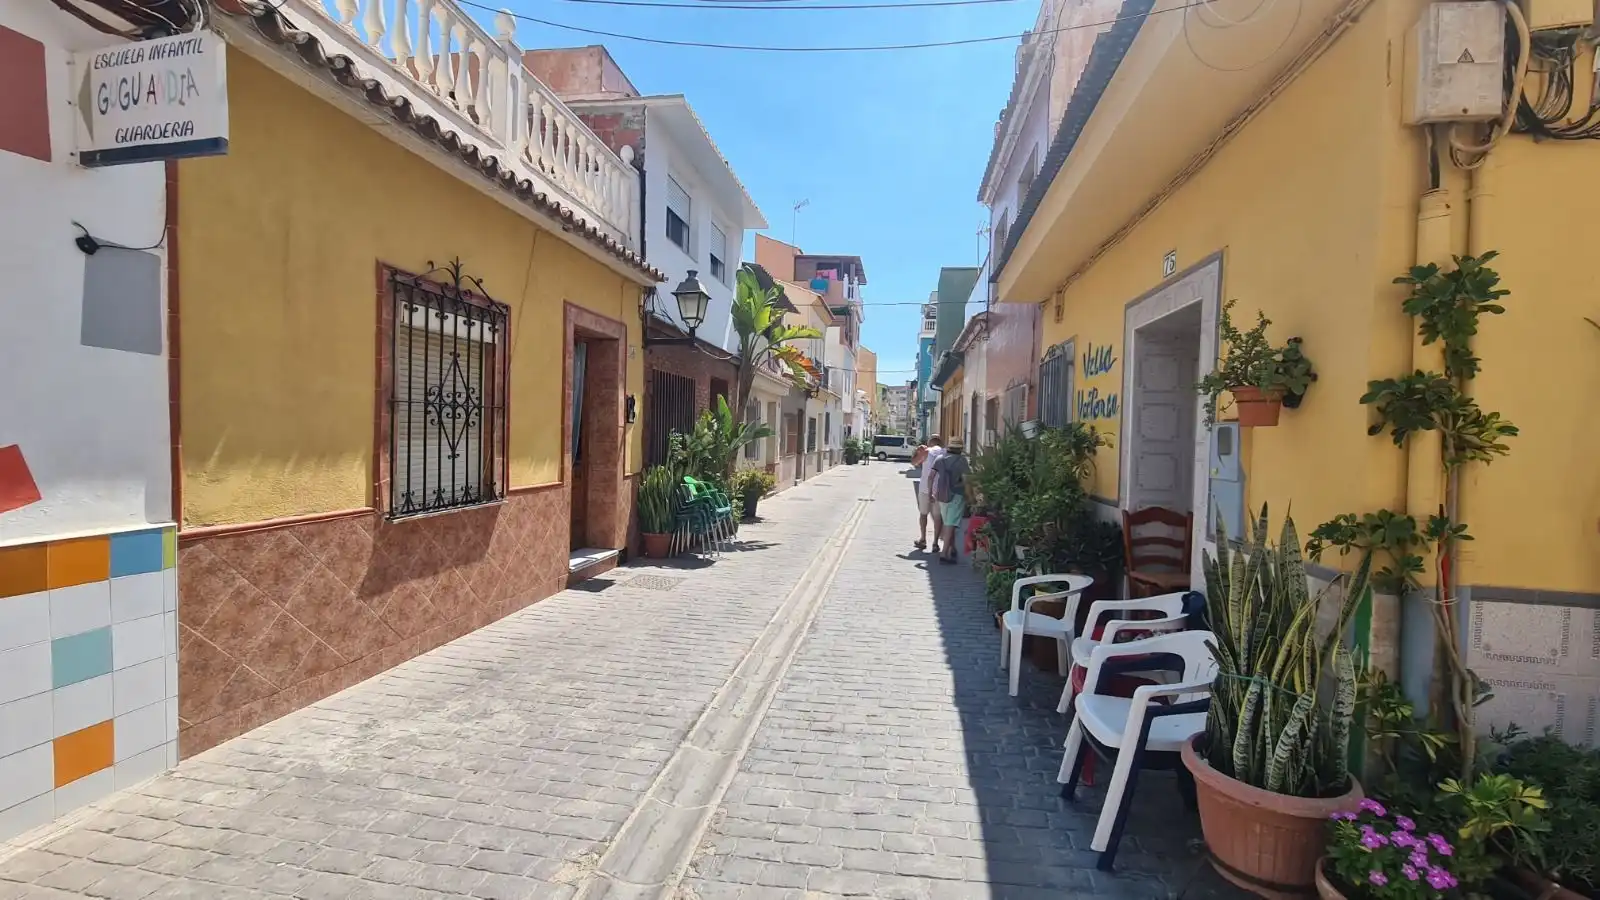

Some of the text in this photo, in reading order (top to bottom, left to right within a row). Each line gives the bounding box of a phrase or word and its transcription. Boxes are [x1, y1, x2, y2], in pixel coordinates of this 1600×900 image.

[94, 37, 204, 70] ESCUELA INFANTIL
[115, 120, 194, 143] GUARDERIA
